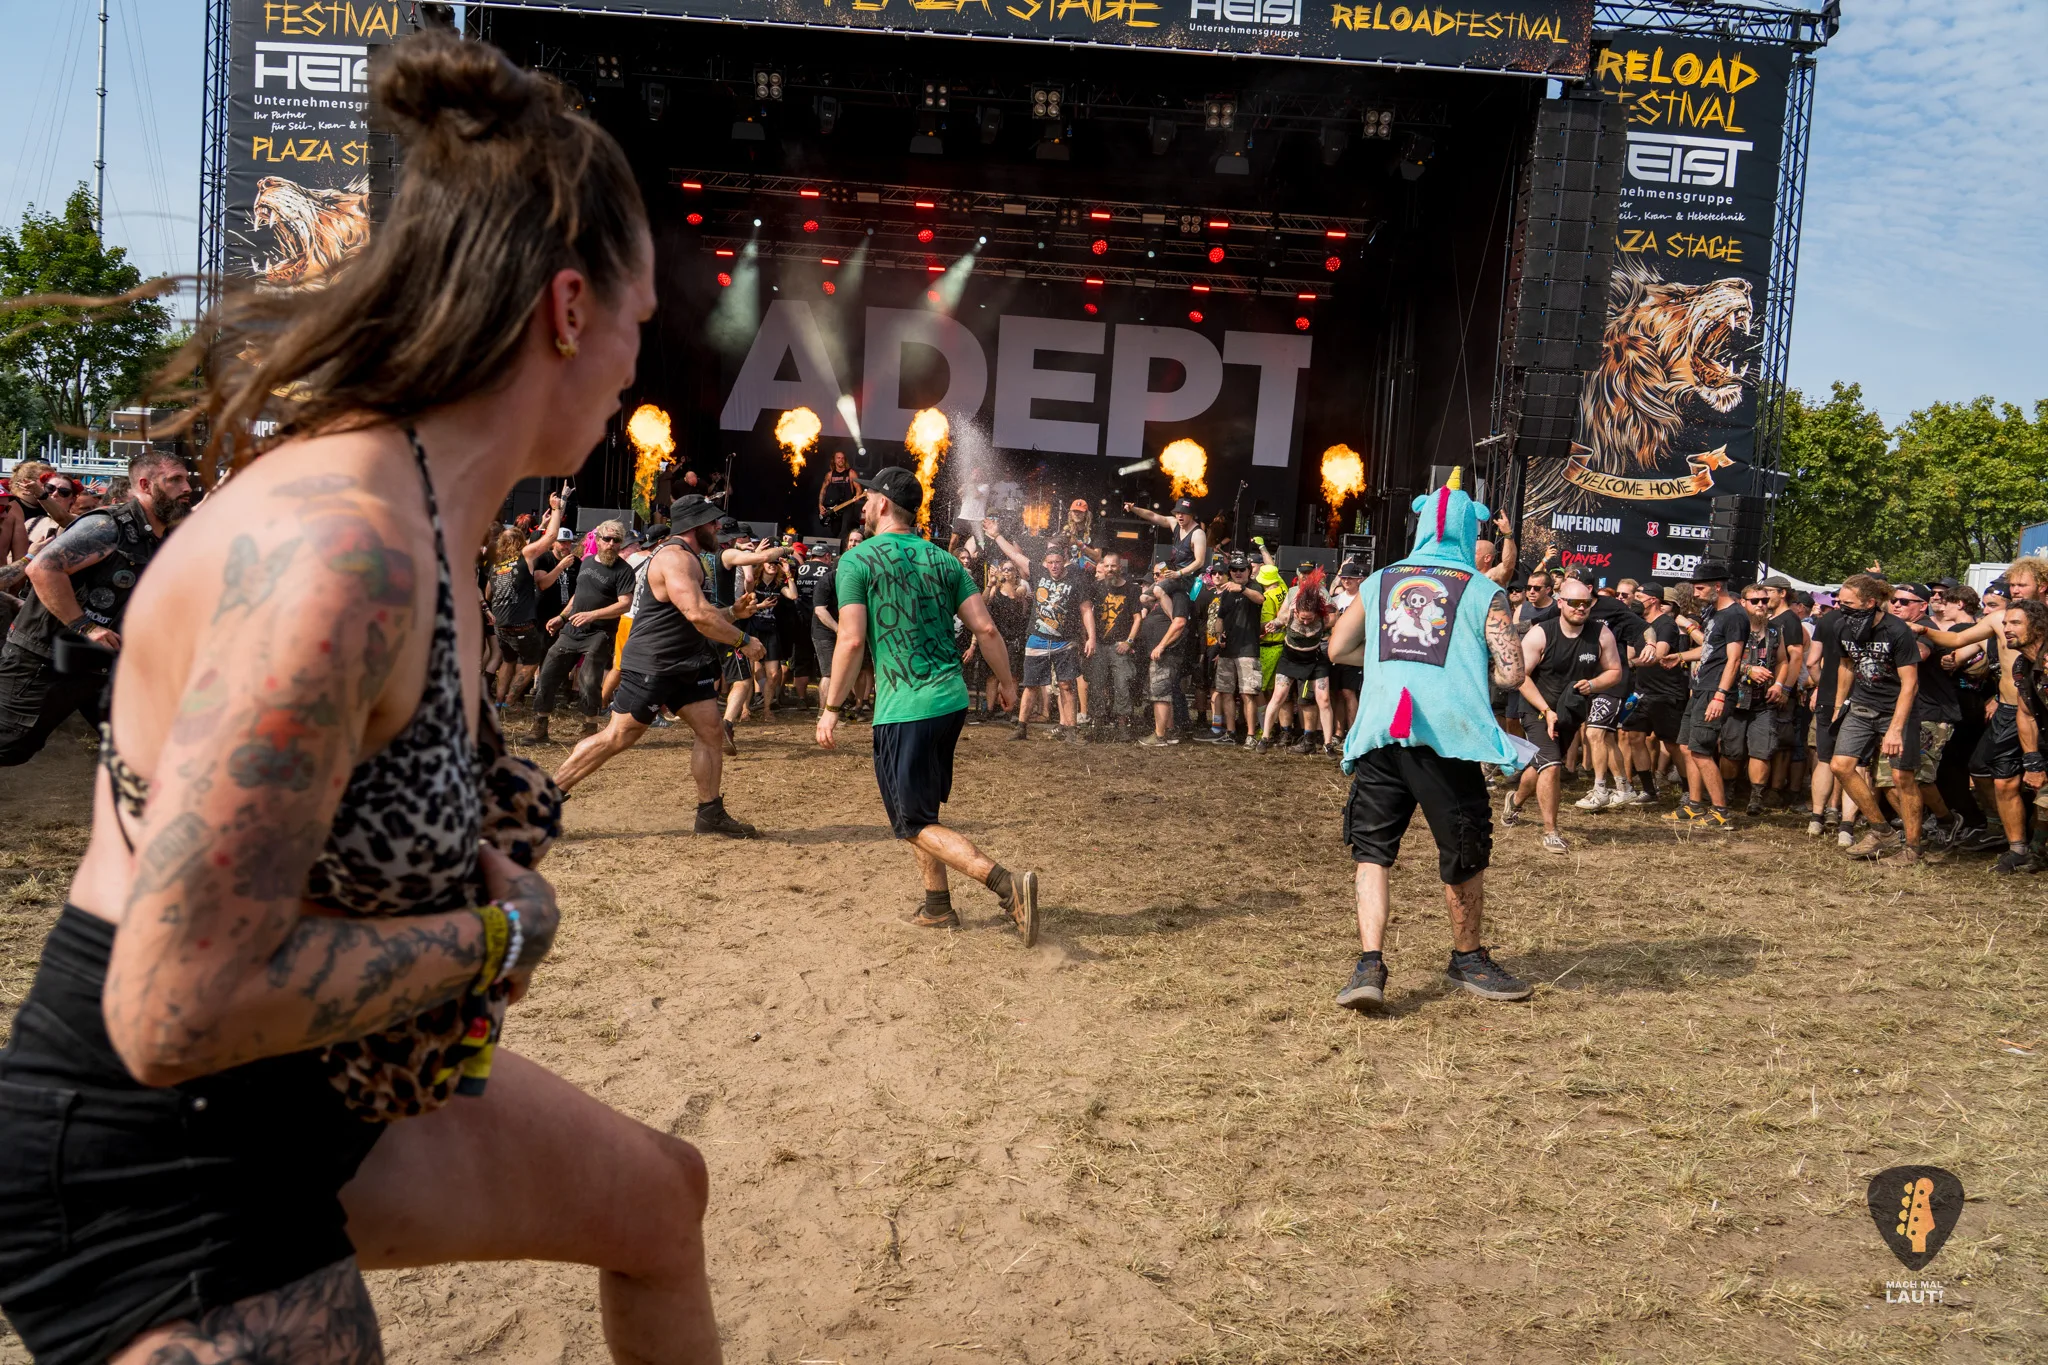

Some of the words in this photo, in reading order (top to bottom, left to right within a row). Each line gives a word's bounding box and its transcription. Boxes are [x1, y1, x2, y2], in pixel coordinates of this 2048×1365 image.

[1189, 23, 1300, 38] Unternehmensgruppe
[1596, 46, 1760, 93] RELOAD
[254, 111, 268, 120] Ihr
[271, 111, 306, 119] Partner
[270, 122, 287, 133] für
[318, 121, 346, 130] Kran-
[349, 121, 357, 129] &
[252, 136, 336, 164] PLAZA
[1624, 132, 1754, 188] EIST
[1644, 211, 1672, 220] Kran-
[1675, 211, 1684, 221] &
[1687, 211, 1746, 222] Hebetechnik
[1615, 229, 1659, 256] ZA
[1666, 232, 1744, 263] STAGE
[719, 299, 1313, 468] ADEPT
[1575, 470, 1644, 496] WELCOME
[1650, 480, 1693, 497] HOME
[1551, 511, 1621, 535] IMPERICON
[856, 541, 946, 575] WE'RE
[1561, 550, 1612, 568] PLAYERS
[1576, 544, 1586, 552] LET
[1588, 545, 1598, 553] THE
[869, 568, 957, 602] TAKING
[876, 592, 954, 630] OVER
[877, 627, 922, 657] THE
[1841, 640, 1890, 653] WAKEN
